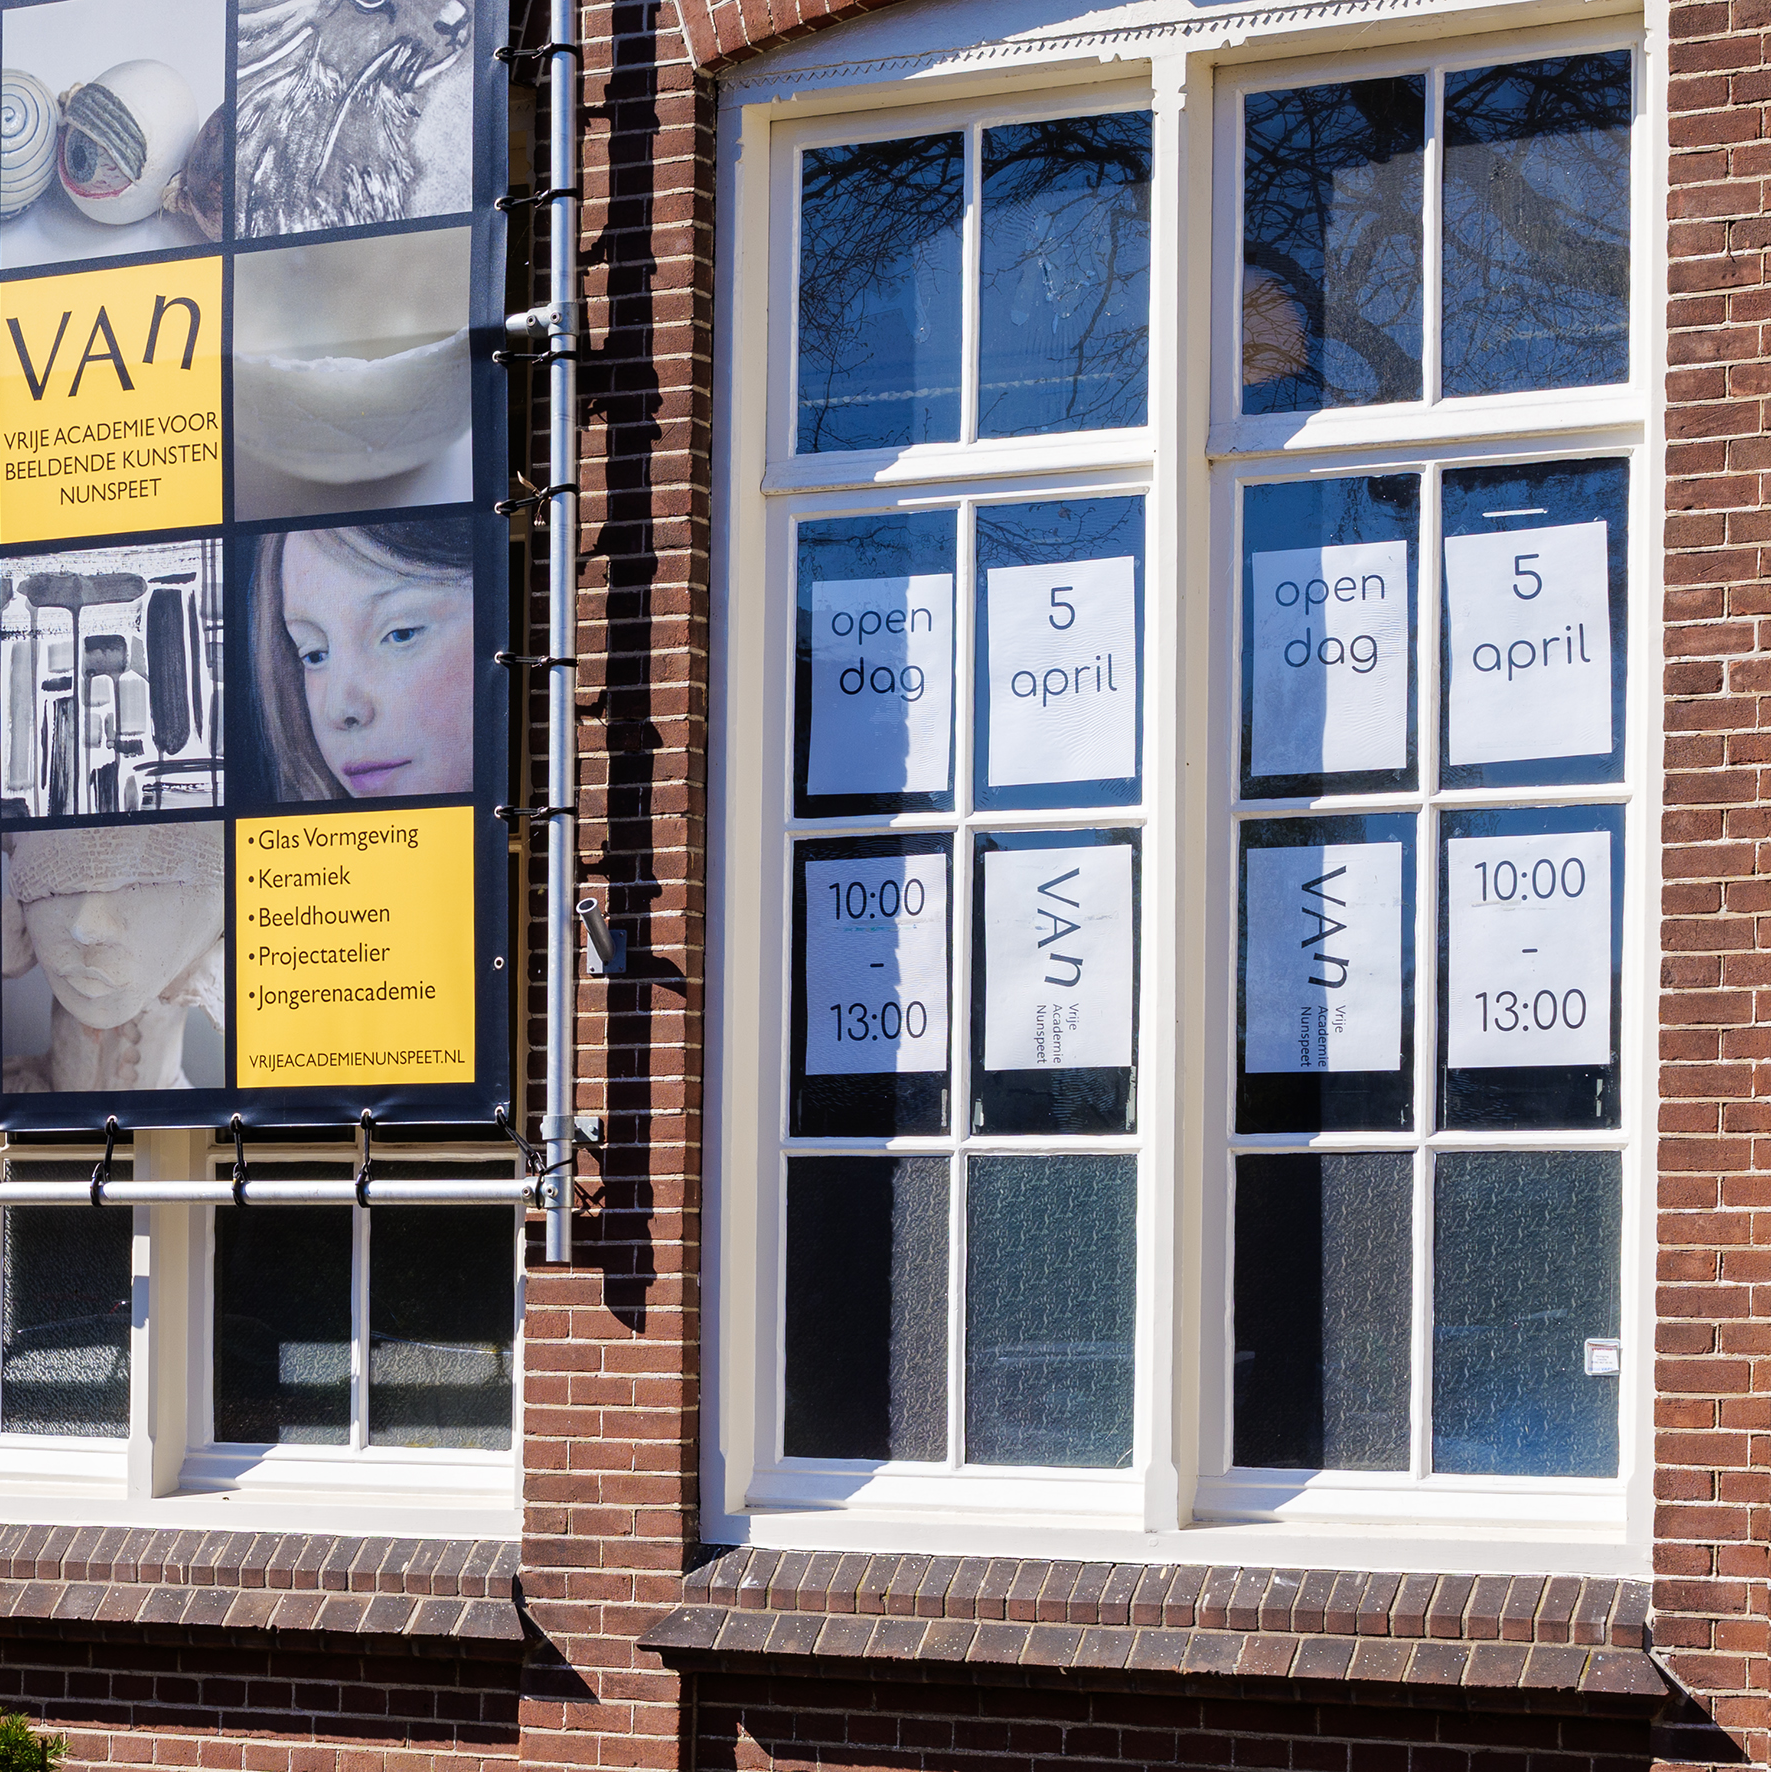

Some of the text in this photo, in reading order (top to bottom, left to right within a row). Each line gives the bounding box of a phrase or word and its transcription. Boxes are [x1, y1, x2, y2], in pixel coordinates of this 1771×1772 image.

[6, 294, 201, 401] VAn
[4, 412, 218, 453] VRIJE ACADEMIE VOOR
[6, 442, 217, 480] BEELDENDE KUNSTEN
[61, 478, 161, 505] NUNSPEET
[1276, 575, 1385, 615] open
[1513, 554, 1542, 599] 5
[831, 608, 932, 645] open
[1049, 587, 1075, 630] 5
[1284, 628, 1377, 673] dag
[1473, 623, 1591, 681] april
[840, 657, 925, 702] dag
[1011, 654, 1117, 707] april
[259, 825, 418, 850] Glas Vormgeving
[259, 866, 350, 888] Keramiek
[1475, 858, 1586, 901] 10:00
[259, 906, 390, 927] Beeldhouwen
[829, 878, 925, 920] 10:00
[1037, 868, 1083, 988] VAn
[1301, 866, 1349, 989] VAn
[259, 943, 390, 970] Projectatelier
[257, 981, 436, 1010] Jongerenacademie
[1068, 1003, 1079, 1030] Vrije
[1475, 989, 1587, 1032] 13:00
[830, 1001, 927, 1041] 13:00
[1037, 1004, 1047, 1064] Nunspeet
[1053, 1004, 1061, 1064] Academie
[1301, 1006, 1311, 1067] Nunspeet
[1318, 1006, 1327, 1067] Academie
[1335, 1005, 1346, 1033] Vrije
[249, 1050, 465, 1071] VRIJEACADEMIENUNSPEET.NL
